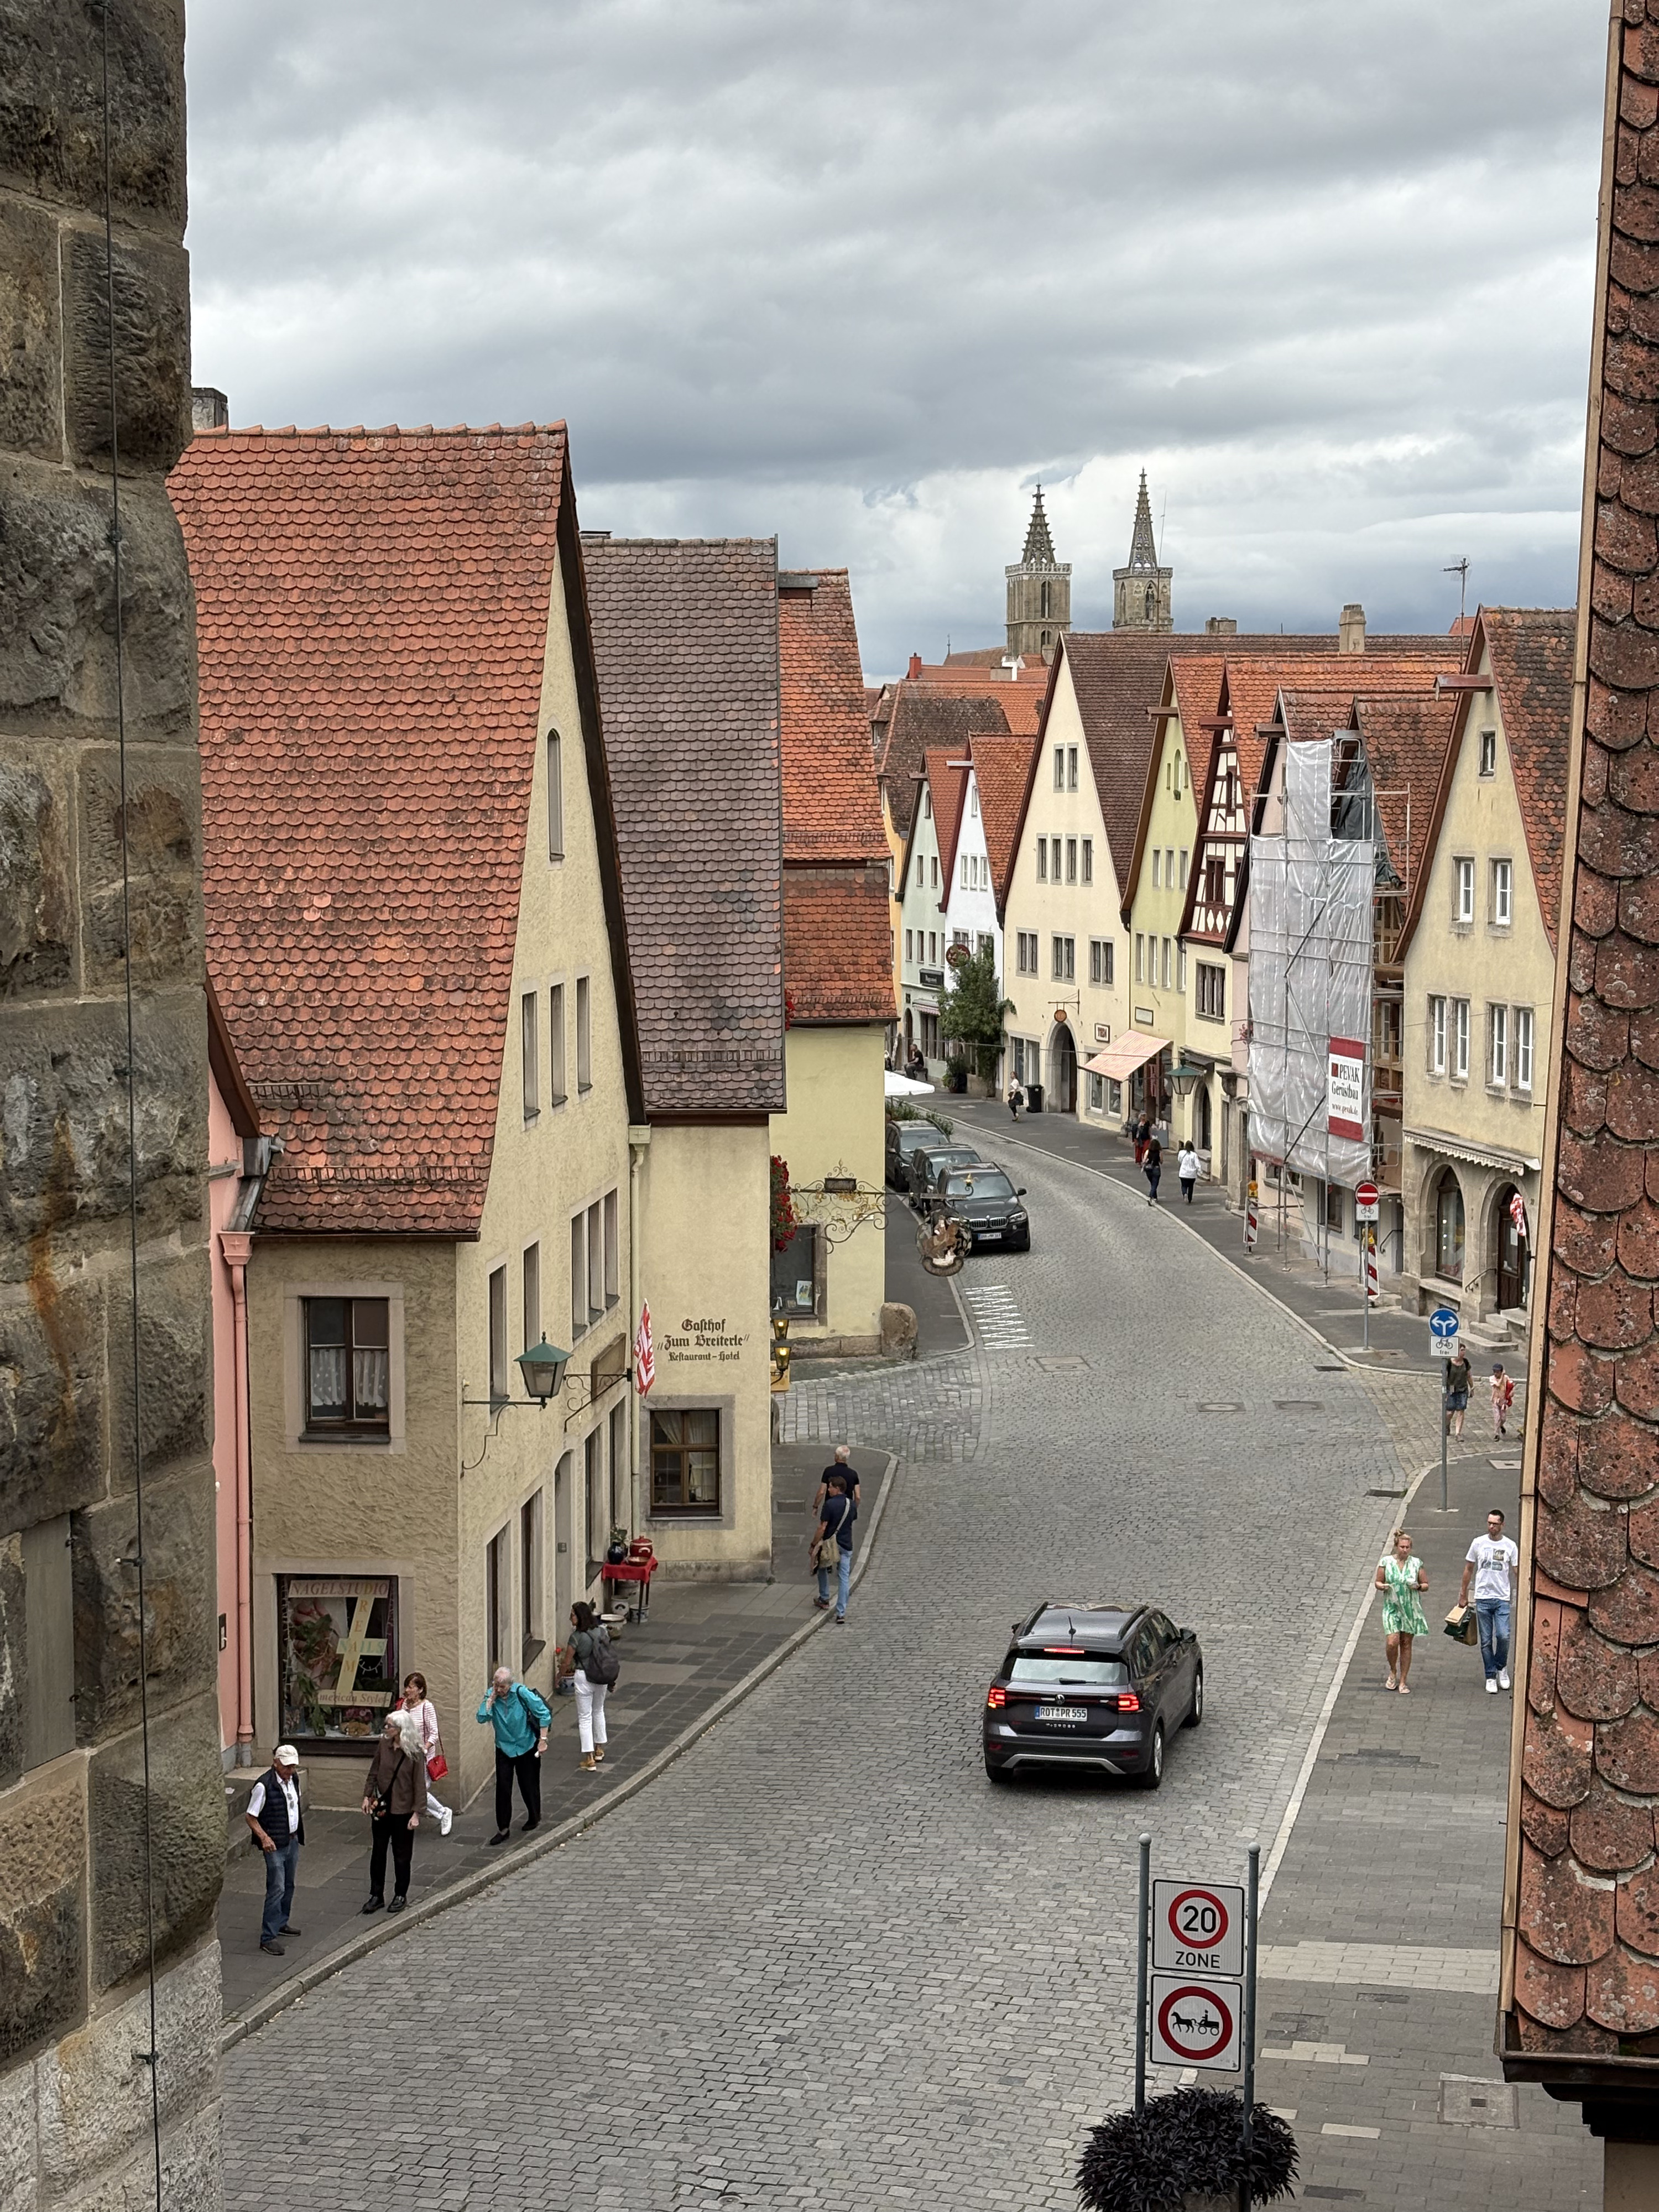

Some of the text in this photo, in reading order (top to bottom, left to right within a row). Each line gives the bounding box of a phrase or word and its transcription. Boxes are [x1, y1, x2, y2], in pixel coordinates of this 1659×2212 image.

[1339, 1063, 1360, 1083] PEVAK
[291, 1582, 388, 1595] NAGELSTUDIO
[339, 1640, 385, 1653] NAILS
[319, 1692, 358, 1703] merican
[1040, 1707, 1086, 1718] ROT PR 555
[1183, 1905, 1216, 1933] 20
[1175, 1950, 1220, 1969] ZONE
